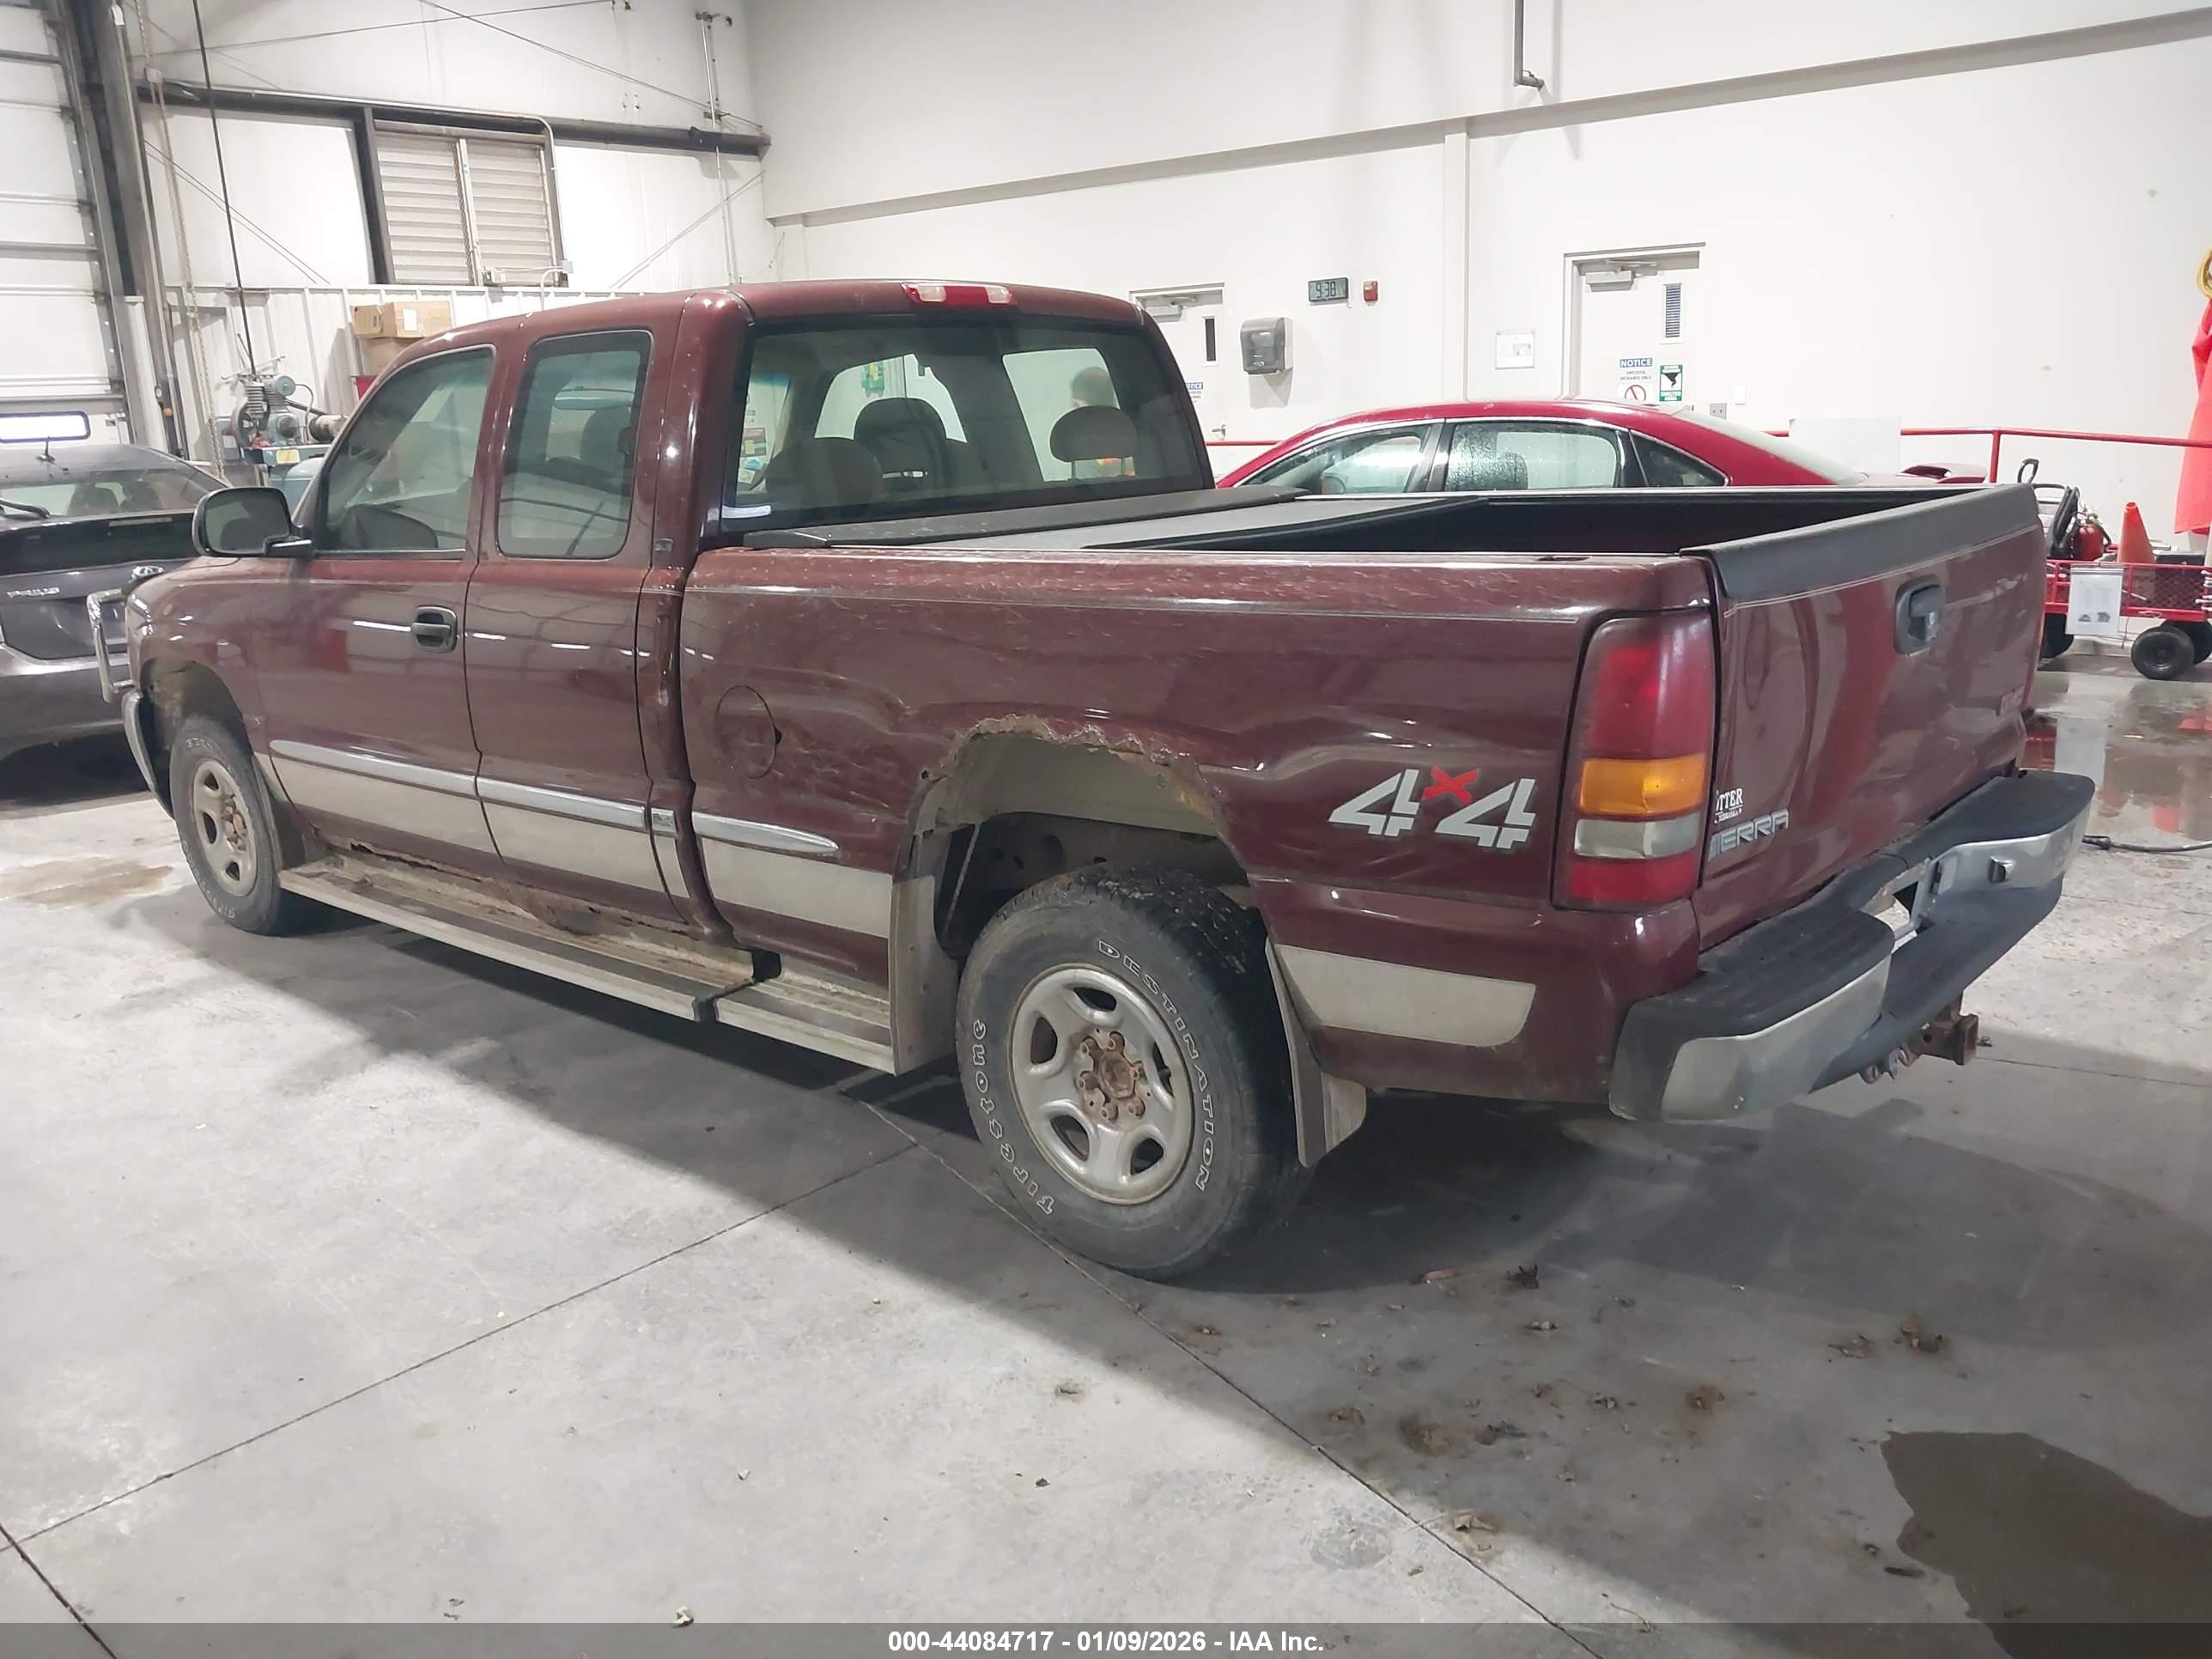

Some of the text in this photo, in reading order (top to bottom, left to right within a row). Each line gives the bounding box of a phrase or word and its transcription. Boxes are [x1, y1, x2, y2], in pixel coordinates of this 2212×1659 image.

[1620, 358, 1651, 368] NOTICE
[1716, 787, 1743, 811] TTER
[1099, 940, 1215, 1192] DESTINATION
